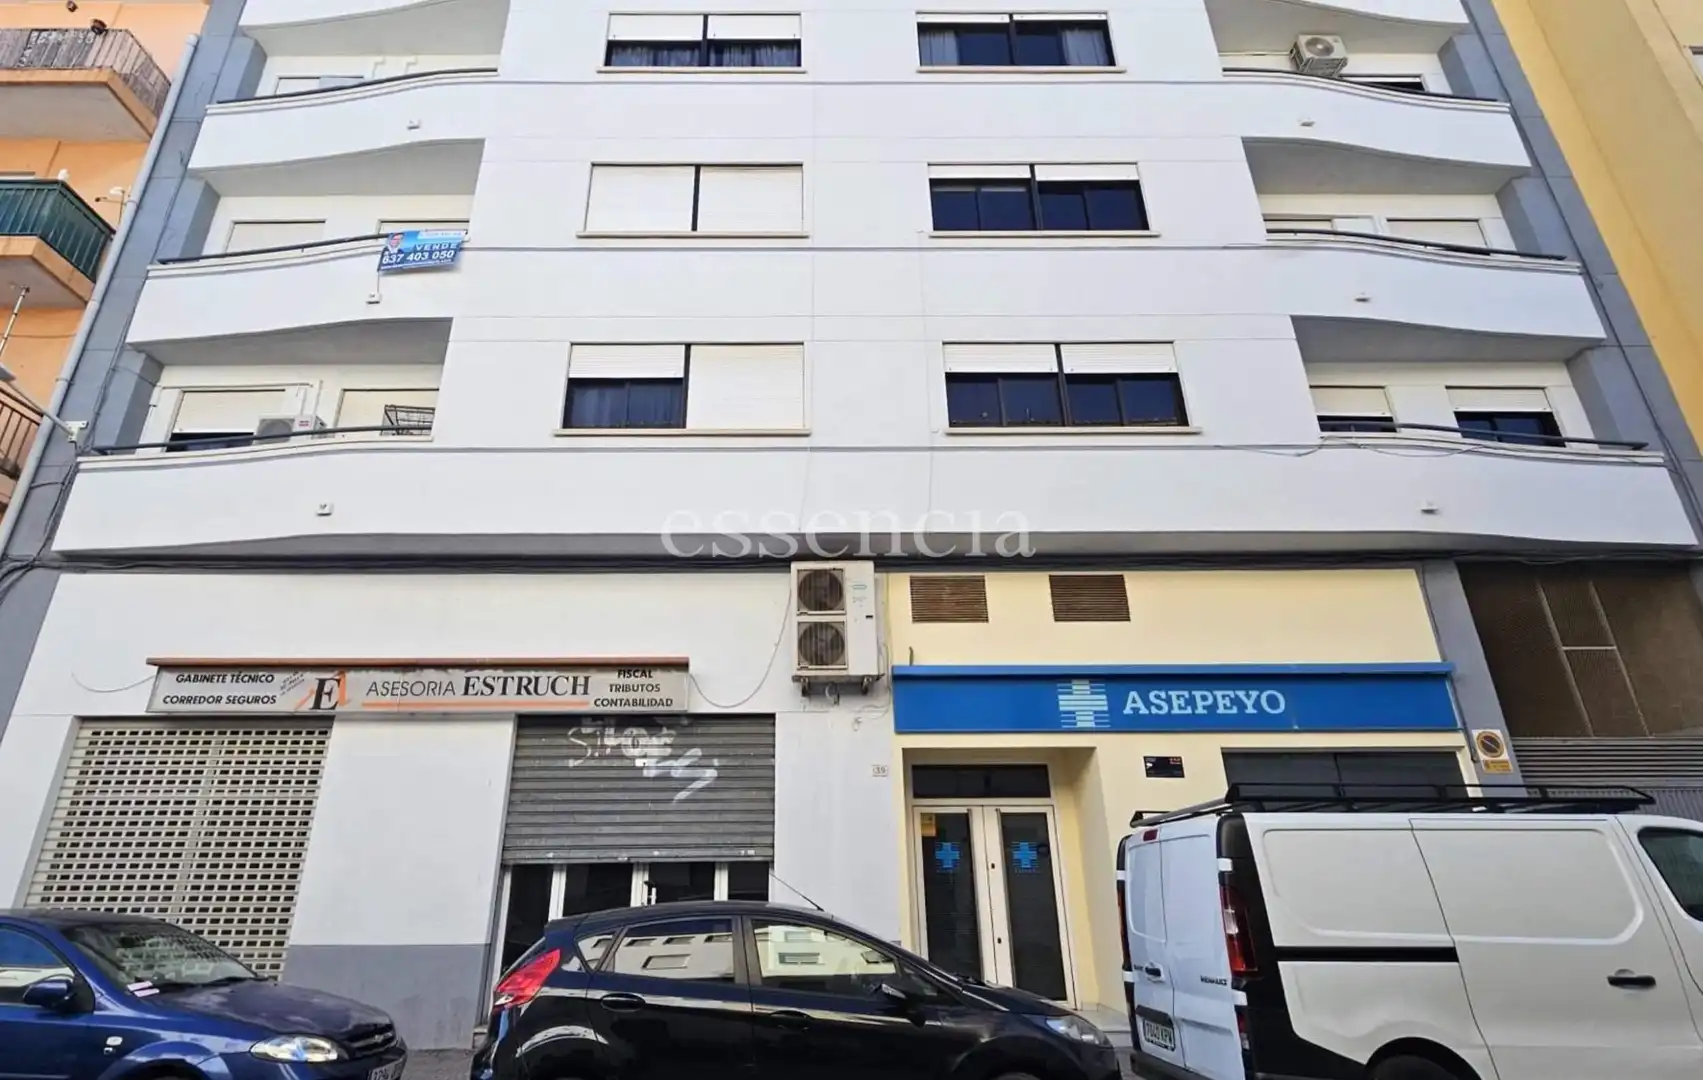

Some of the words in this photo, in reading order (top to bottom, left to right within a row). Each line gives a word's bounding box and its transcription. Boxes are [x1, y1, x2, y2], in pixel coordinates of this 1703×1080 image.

[415, 243, 458, 251] VENDE
[406, 251, 429, 261] 403
[432, 250, 455, 260] 050
[176, 673, 227, 684] GABINETE
[229, 671, 275, 684] TÉCNICO
[617, 669, 654, 679] FISCAL
[366, 680, 456, 697] ASESORIA
[461, 675, 591, 697] ESTRUCH
[609, 683, 661, 693] TRIBUTOS
[162, 695, 222, 705] CORREDOR
[225, 695, 277, 705] SEGUROS
[593, 698, 674, 708] CONTABILIDAD
[1122, 689, 1286, 715] ASEPEYO
